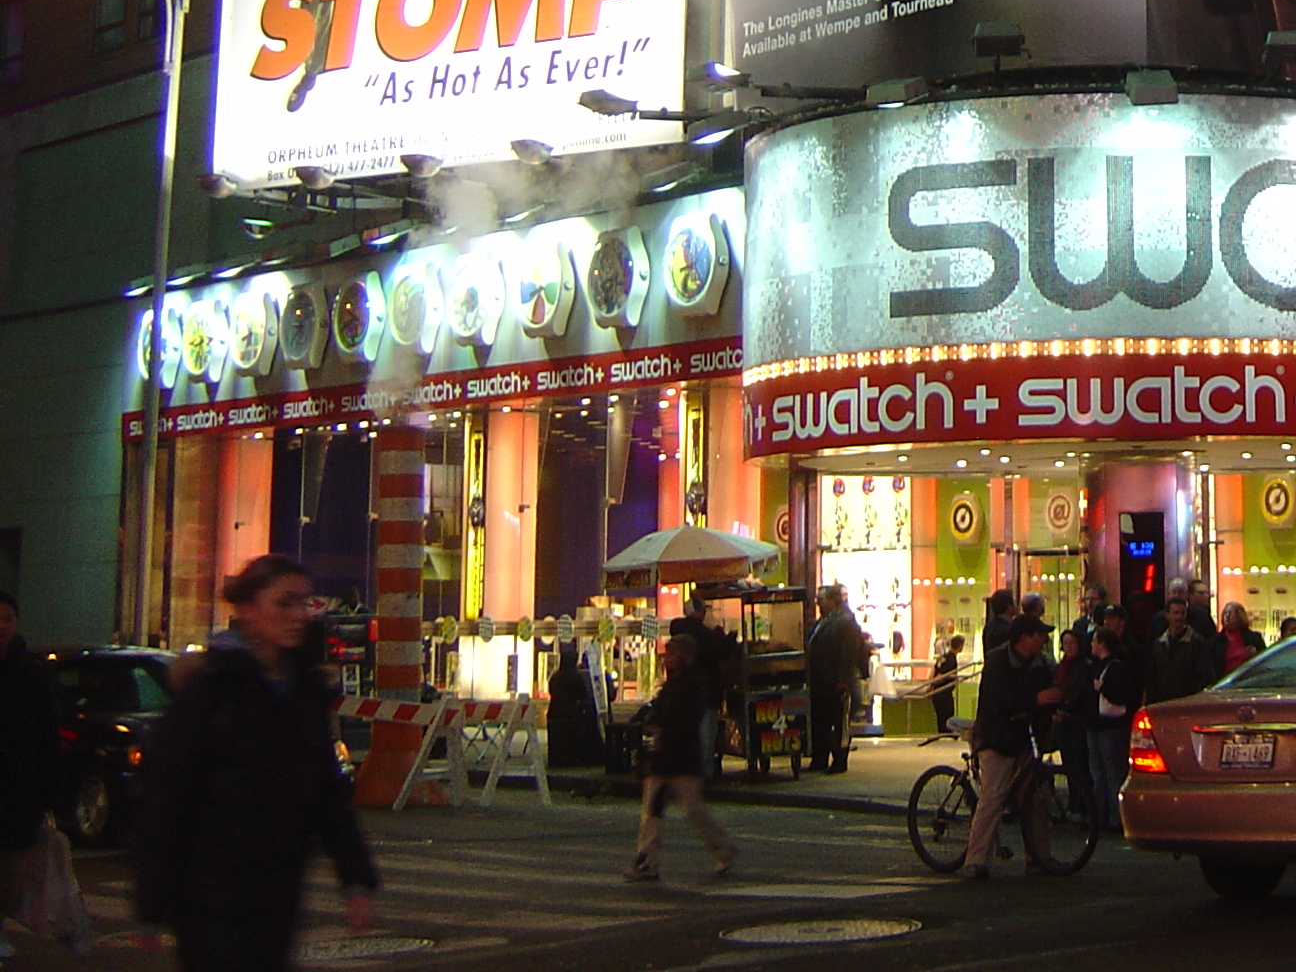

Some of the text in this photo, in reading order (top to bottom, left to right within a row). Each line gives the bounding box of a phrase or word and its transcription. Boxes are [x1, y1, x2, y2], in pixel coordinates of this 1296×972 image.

[742, 32, 796, 58] Available
[799, 26, 812, 42] at
[815, 15, 861, 38] Wempe
[864, 5, 889, 26] and
[743, 21, 765, 38] The
[768, 5, 823, 31] Longines
[429, 63, 482, 100] Hot
[495, 56, 531, 91] As
[267, 144, 338, 165] ORPHEUM
[772, 372, 954, 443] swatch
[1018, 365, 1287, 426] swatch
